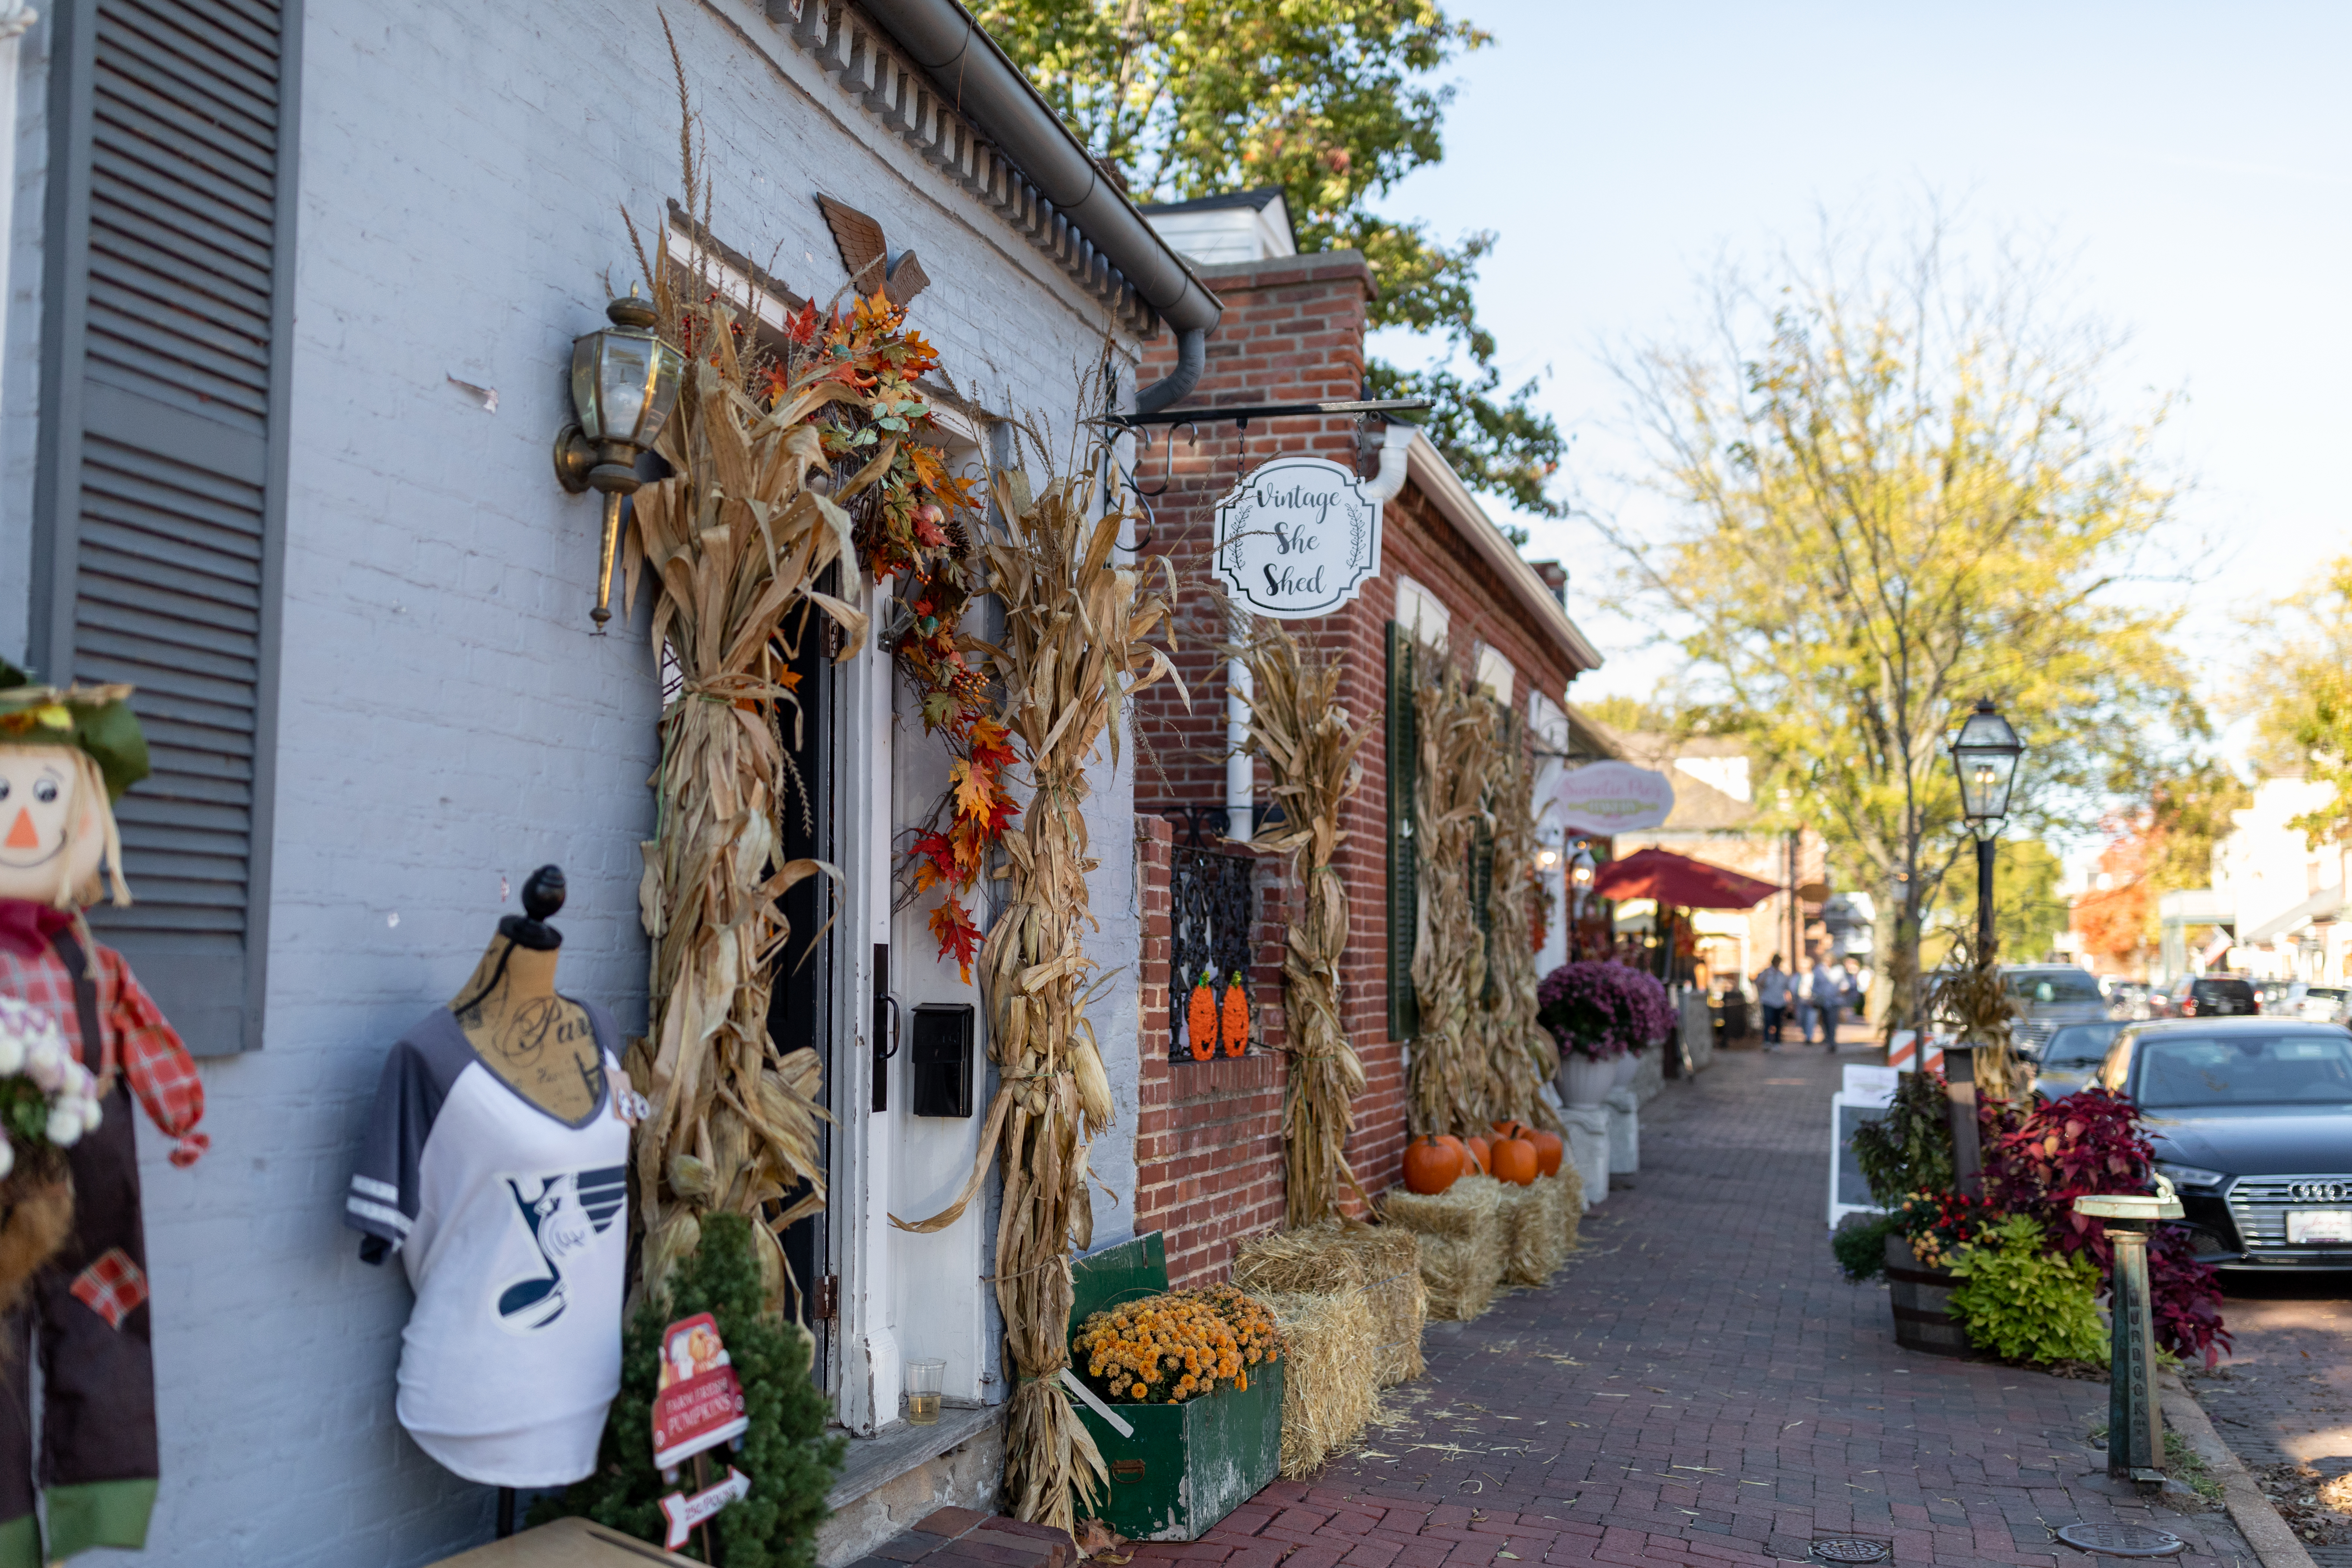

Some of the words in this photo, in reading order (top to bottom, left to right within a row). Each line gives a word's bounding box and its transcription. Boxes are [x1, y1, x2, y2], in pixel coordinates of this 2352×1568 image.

[1257, 483, 1342, 524] Vintage
[1274, 521, 1320, 555] She
[1263, 563, 1327, 596] Shed
[667, 1393, 731, 1437] PUMPKINS
